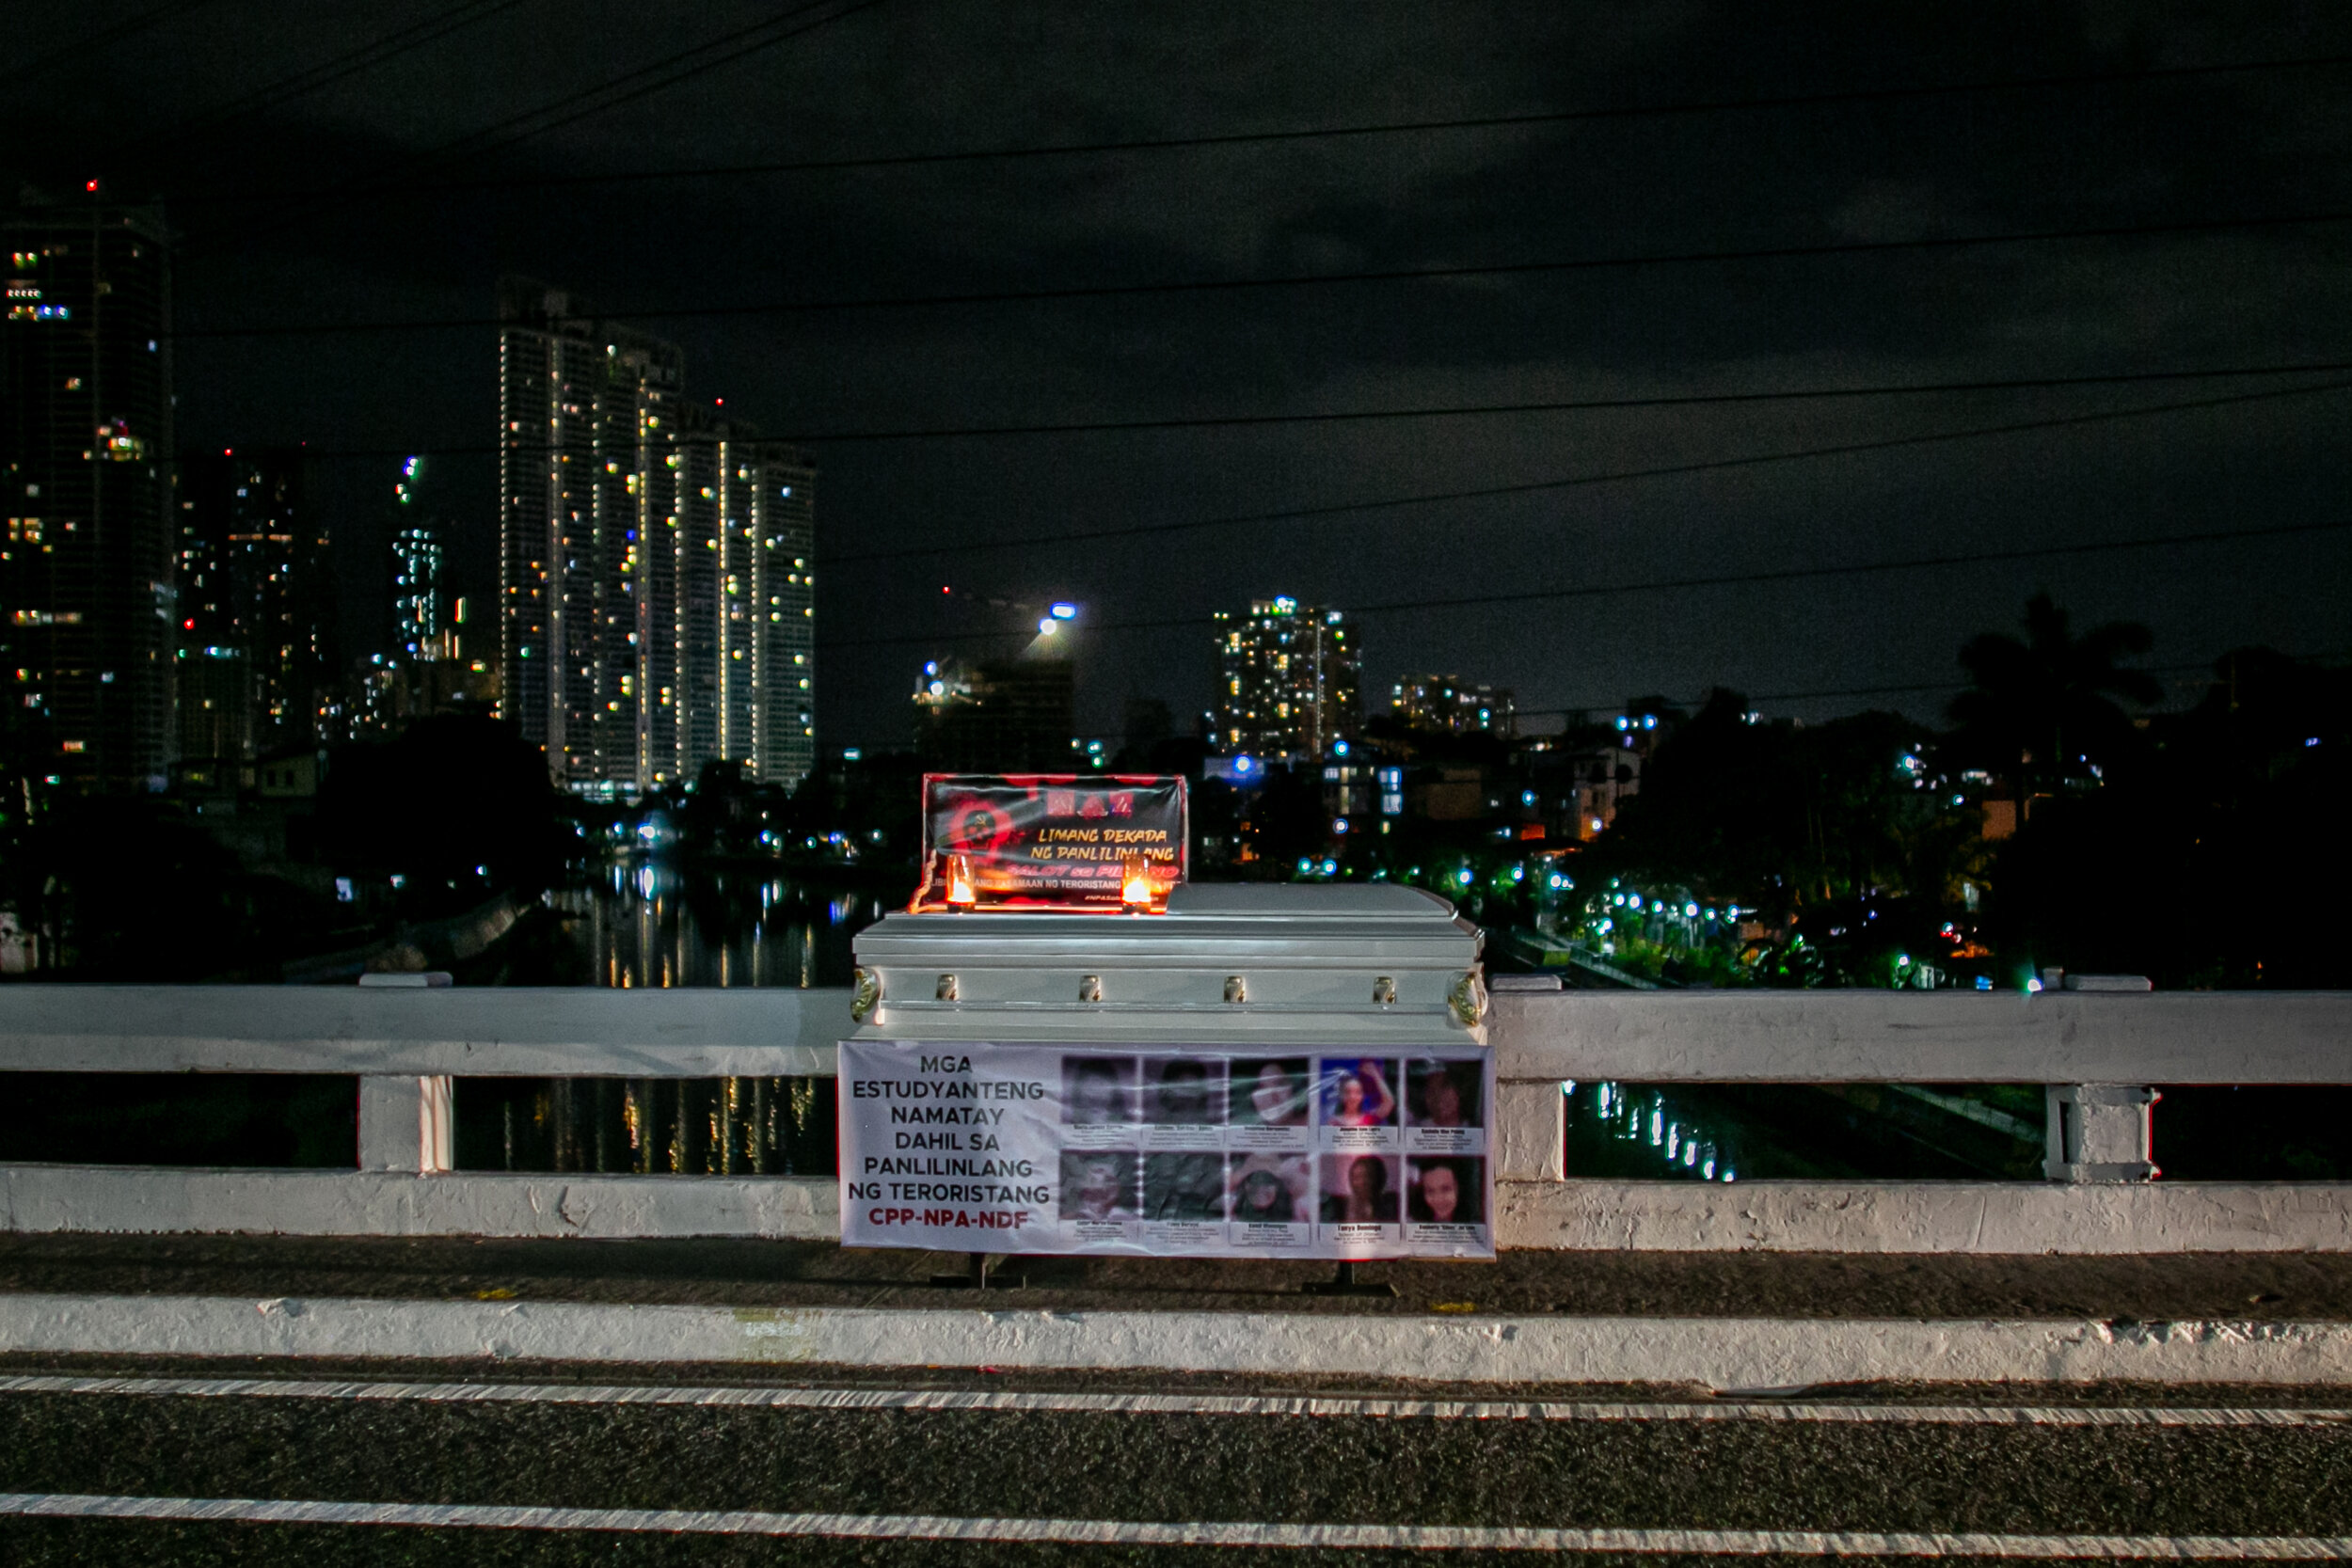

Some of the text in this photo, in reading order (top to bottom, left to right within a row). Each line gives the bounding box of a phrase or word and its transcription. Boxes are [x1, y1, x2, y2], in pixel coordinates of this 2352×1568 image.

[1039, 829, 1168, 843] LIMANG DEKADA
[1030, 847, 1053, 860] NG
[1006, 864, 1072, 877] SALOT
[1045, 879, 1058, 888] NG
[1060, 879, 1121, 889] TERORISTANG
[920, 1055, 973, 1073] MGA
[852, 1081, 1044, 1101] ESTUDYANTENG
[891, 1107, 1005, 1126] NAMATAY
[896, 1132, 1000, 1151] DAHIL SA
[865, 1157, 1033, 1178] PANLILINLANG
[848, 1182, 1050, 1204] NG TERORISTANG
[868, 1208, 1029, 1229] CPP-NPA-NDF
